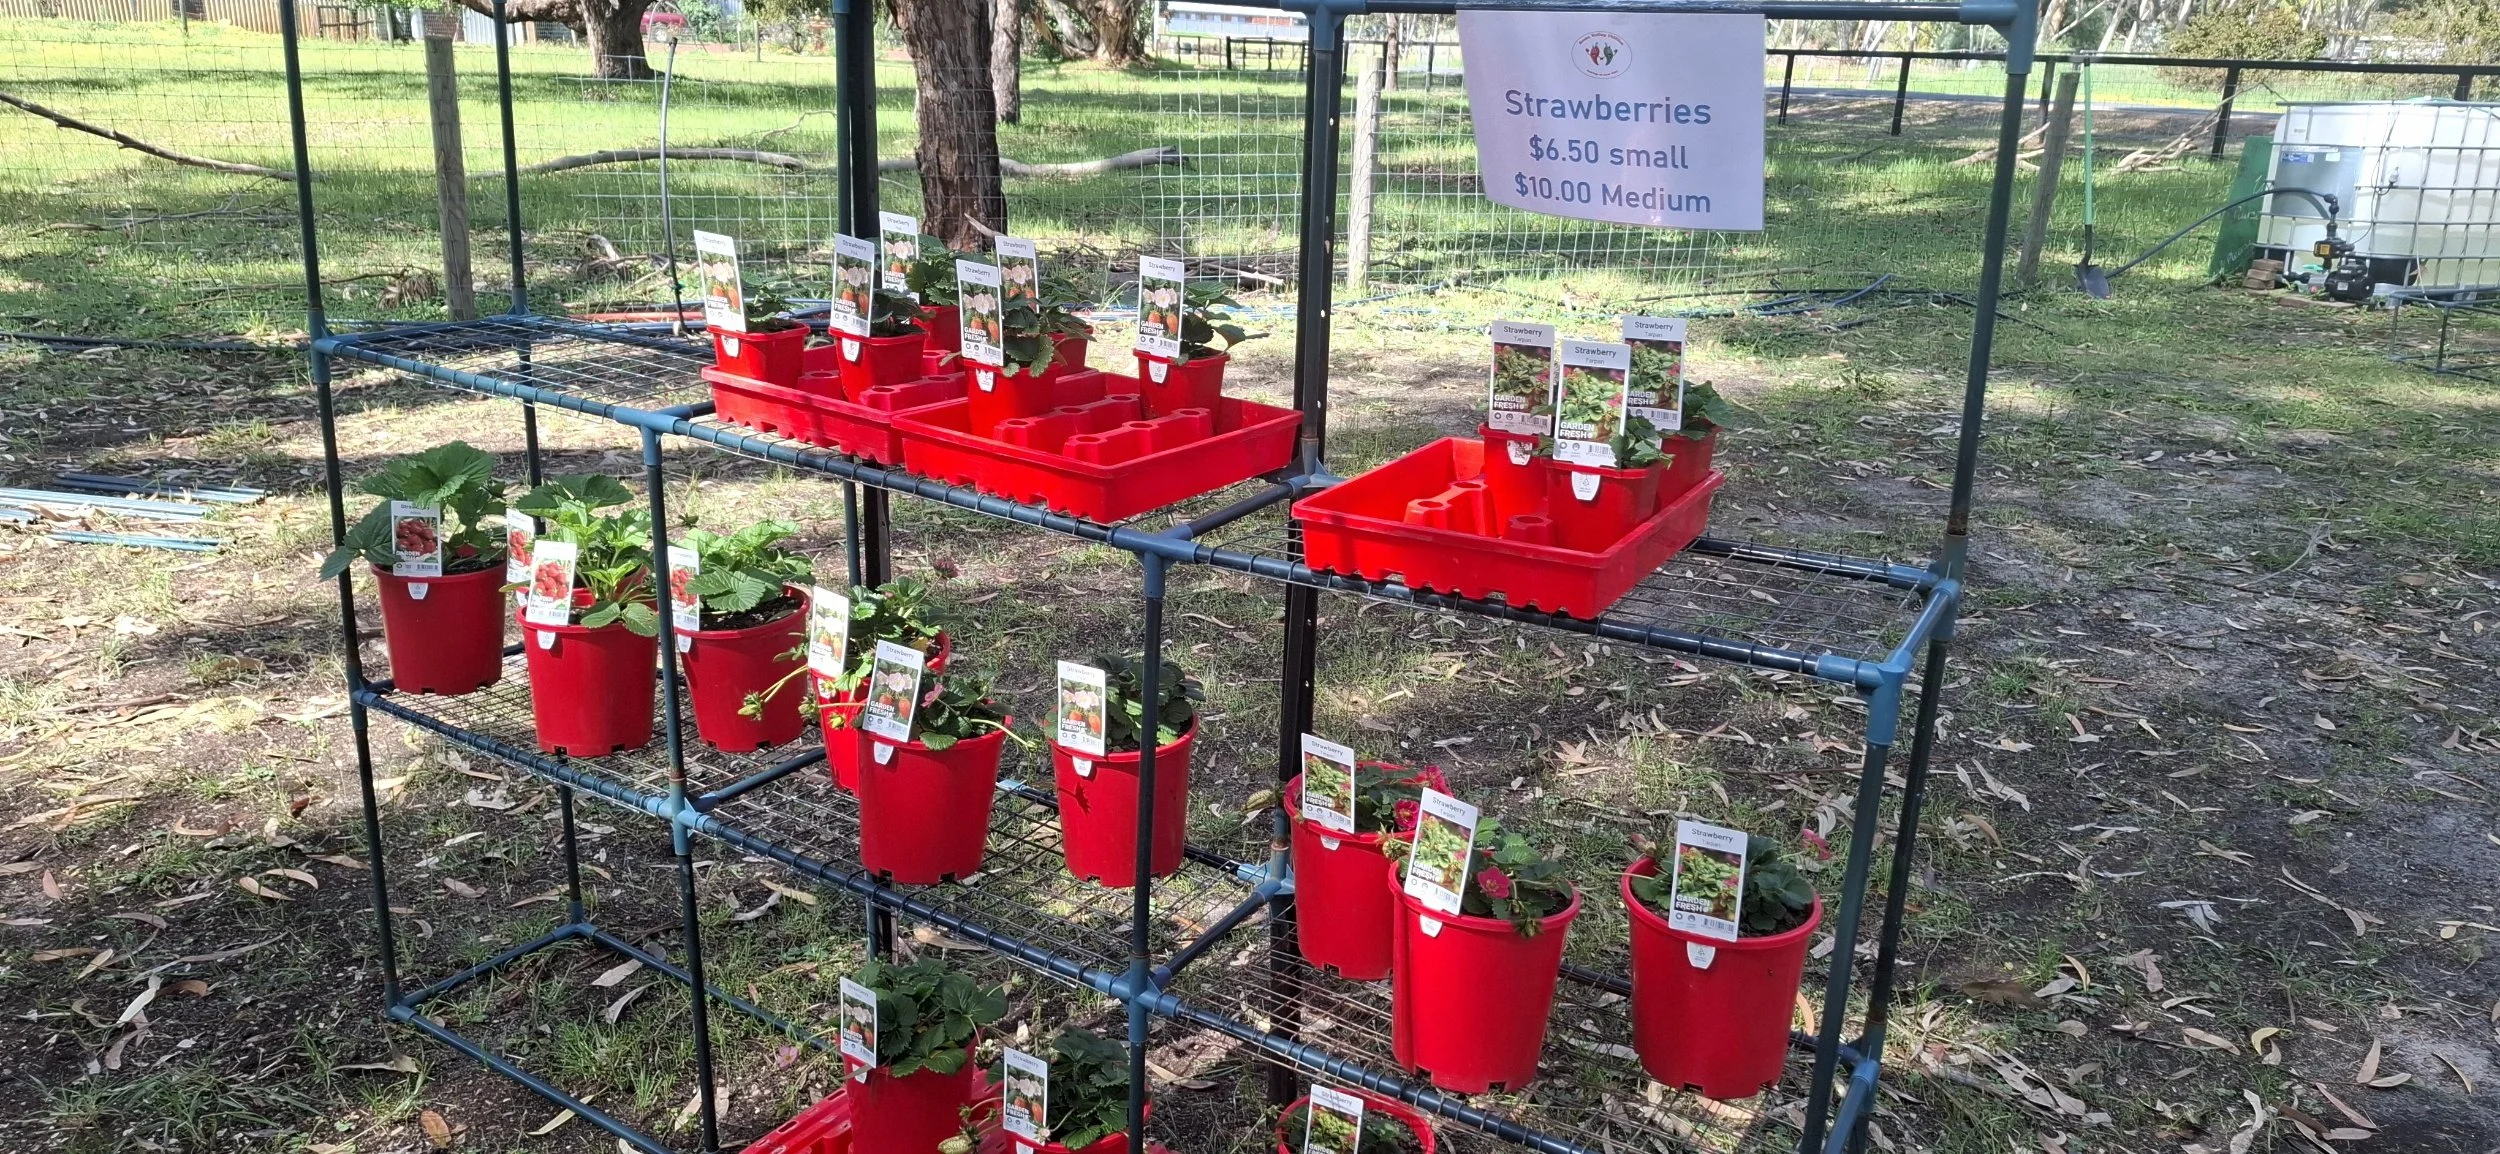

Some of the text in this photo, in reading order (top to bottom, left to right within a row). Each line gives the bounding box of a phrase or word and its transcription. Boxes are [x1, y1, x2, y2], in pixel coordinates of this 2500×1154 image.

[1505, 89, 1712, 125] Strawberries
[1529, 134, 1689, 170] $6.50 small
[1514, 171, 1711, 213] $10.00 Medium
[842, 239, 867, 251] Strawberry
[1003, 240, 1027, 250] Strawberry
[964, 266, 991, 278] Strawberry
[1148, 261, 1176, 273] Strawberry
[834, 303, 852, 313] FRESH
[835, 297, 857, 308] GARDEN
[1141, 319, 1164, 330] GARDEN
[1634, 321, 1674, 332] Strawberry
[964, 326, 987, 337] GARDEN
[1140, 326, 1158, 336] FRESH
[1503, 325, 1543, 338] Strawberry
[964, 333, 982, 342] FRESH
[1574, 346, 1617, 359] Strawberry
[1494, 394, 1526, 404] GARDEN
[1494, 401, 1520, 411] FRESH
[1560, 421, 1595, 432] GARDEN
[1559, 429, 1587, 439] FRESH
[886, 645, 915, 660] Strawberry
[1067, 665, 1096, 679] Strawberry
[869, 706, 889, 718] FRESH
[870, 700, 896, 713] GARDEN
[1061, 717, 1086, 728] GARDEN
[1061, 723, 1081, 733] FRESH
[1311, 740, 1344, 756] Strawberry
[1306, 791, 1333, 804] GARDEN
[1306, 796, 1329, 807] FRESH
[1432, 796, 1467, 816] Strawberry
[1691, 828, 1734, 843] Strawberry
[1413, 860, 1443, 876] GARDEN
[1411, 867, 1436, 882] FRESH
[1676, 894, 1711, 907] GARDEN
[1675, 901, 1704, 913] FRESH
[847, 983, 870, 998] Strawberry
[843, 1027, 863, 1040] GARDEN
[1012, 1053, 1039, 1069] Strawberry
[1006, 1103, 1030, 1115] GARDEN
[1006, 1109, 1024, 1119] FRESH
